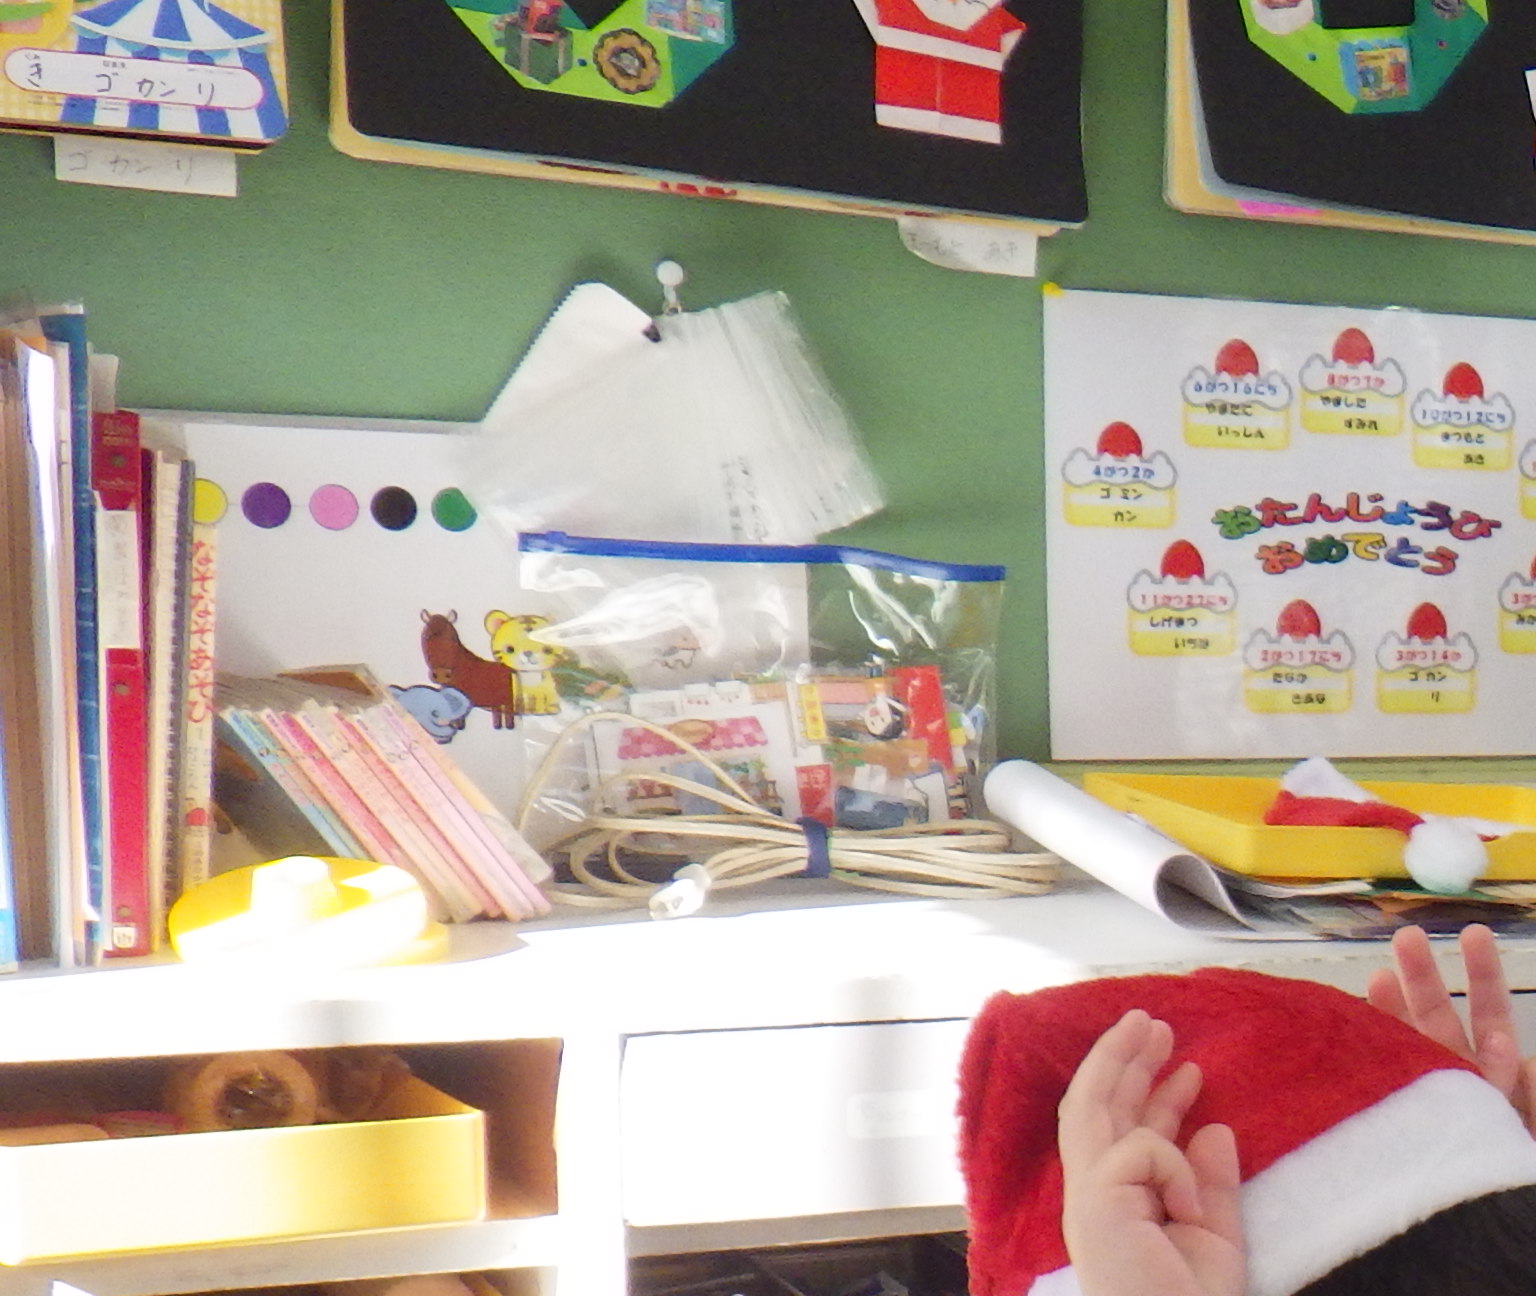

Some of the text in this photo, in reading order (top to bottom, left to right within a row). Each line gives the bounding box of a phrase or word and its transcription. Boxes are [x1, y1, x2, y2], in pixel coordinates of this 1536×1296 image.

[137, 79, 176, 98] カン
[1255, 534, 1459, 576] おめでとう
